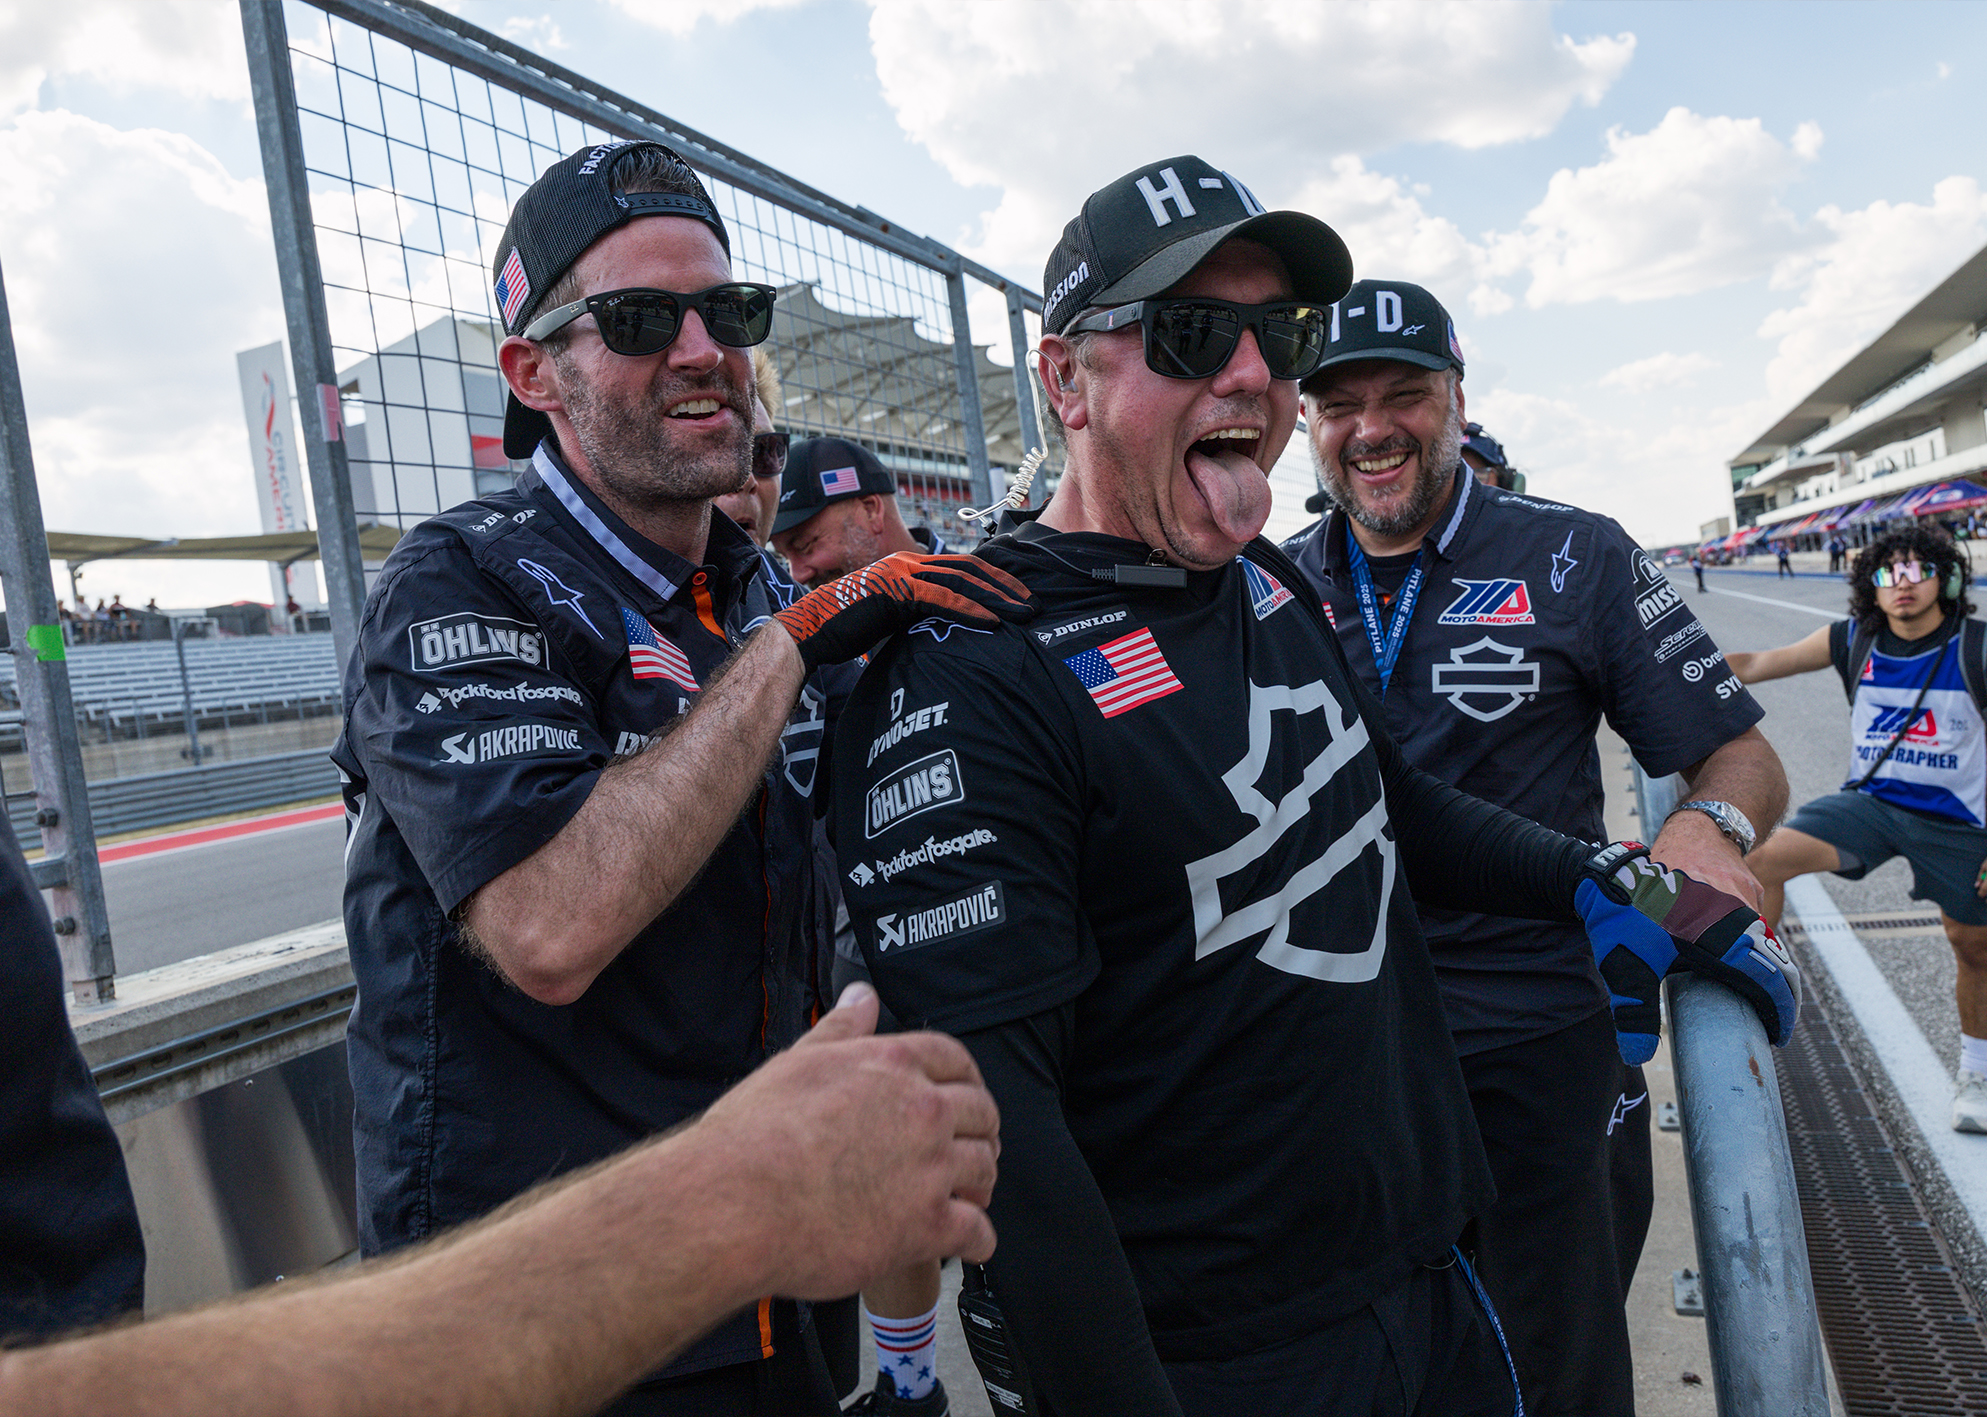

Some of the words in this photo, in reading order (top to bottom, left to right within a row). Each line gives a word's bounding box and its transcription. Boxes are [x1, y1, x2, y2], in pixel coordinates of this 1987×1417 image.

[265, 445, 286, 531] AMERI
[1509, 495, 1575, 512] DUNLOP
[483, 508, 538, 527] DUOP
[1360, 583, 1372, 605] 2025
[1399, 568, 1423, 614] PITLANE
[1053, 610, 1128, 638] DUNLOP
[1364, 606, 1383, 653] PITLANE
[1391, 614, 1406, 638] 2025
[1440, 615, 1534, 625] MOTOAMERICA
[420, 622, 541, 666] ÖHLINS
[1701, 650, 1724, 669] bre
[871, 762, 954, 830] ÖHLINS
